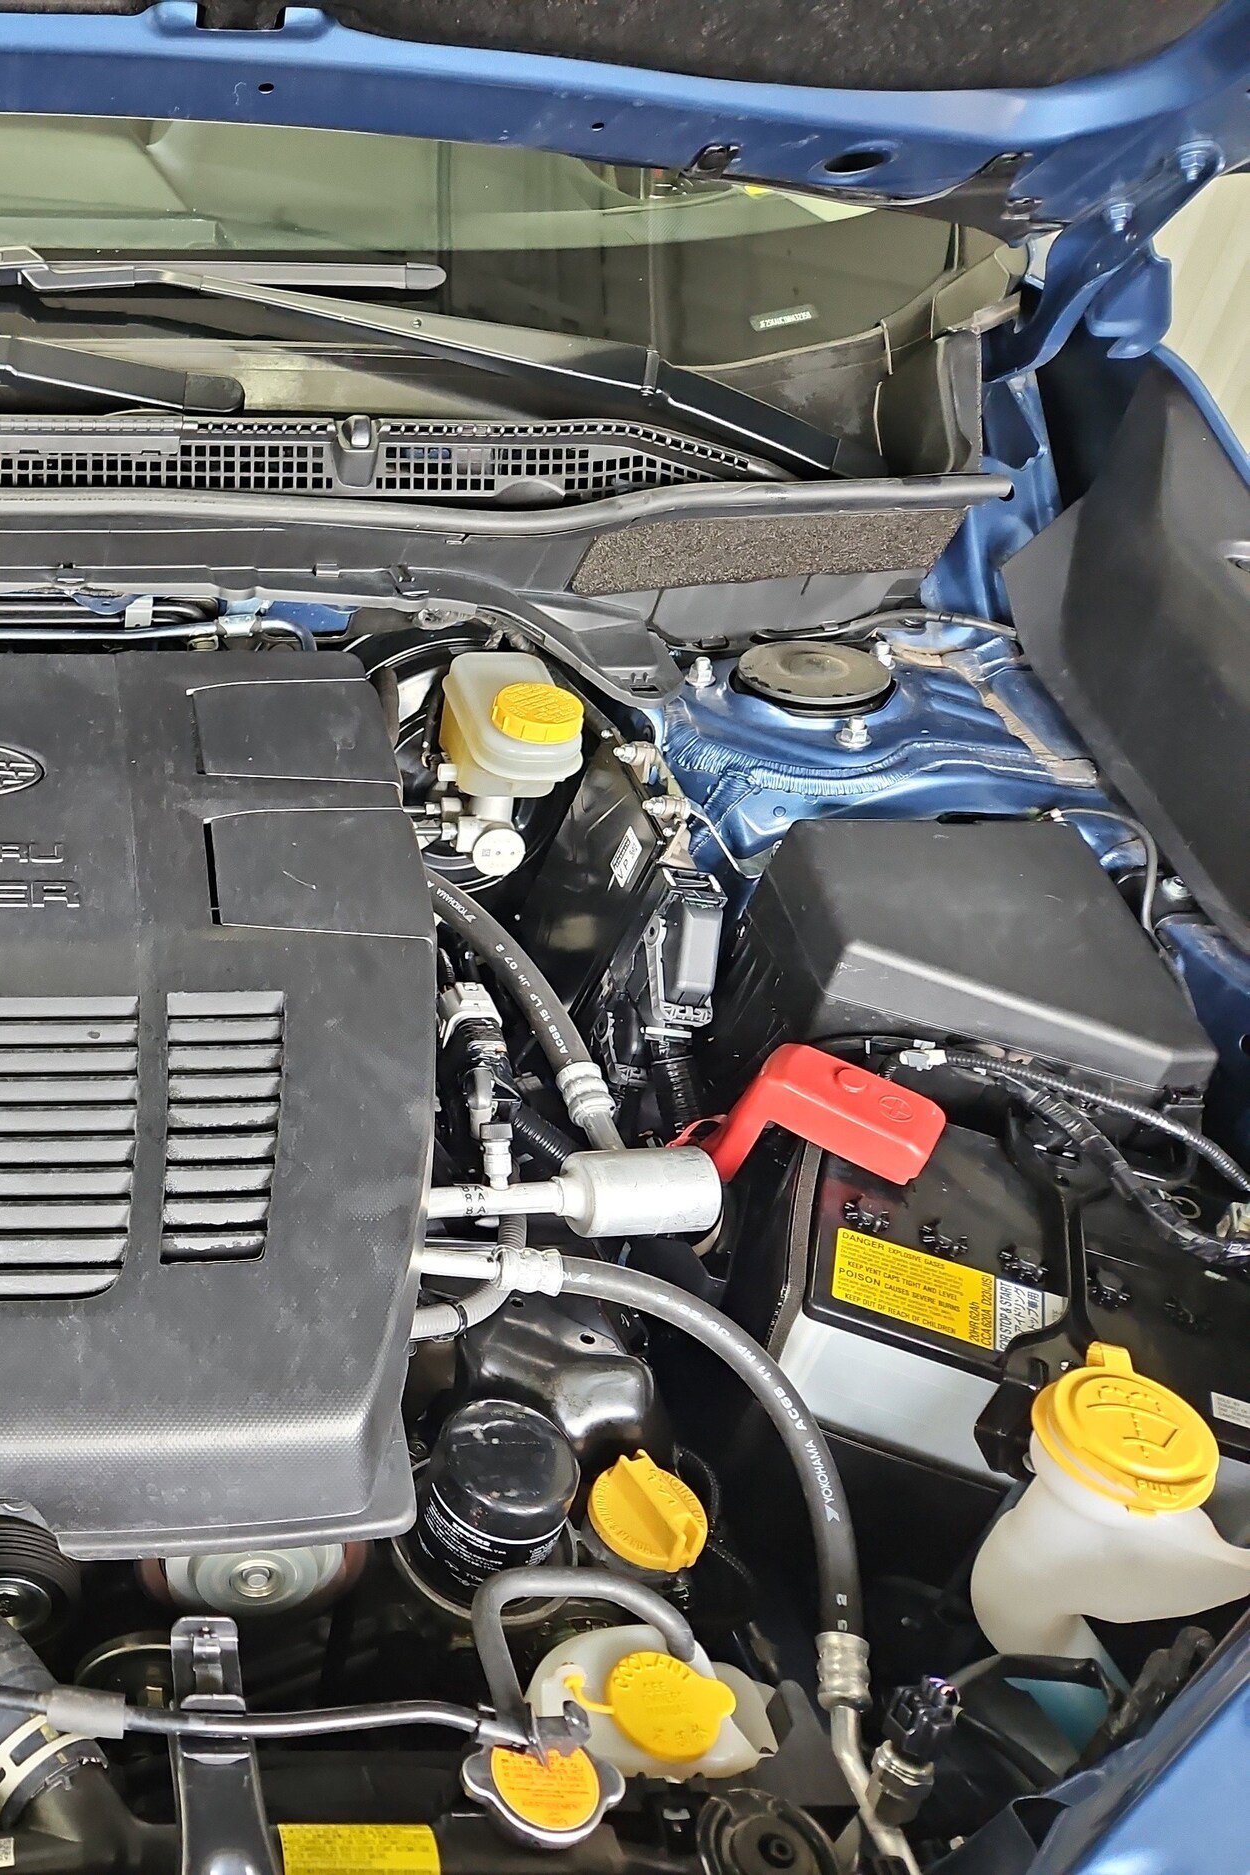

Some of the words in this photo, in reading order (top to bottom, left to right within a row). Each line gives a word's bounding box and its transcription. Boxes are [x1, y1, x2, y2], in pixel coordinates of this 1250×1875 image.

[436, 887, 469, 919] YOKOHAMA
[495, 943, 506, 954] 2
[504, 955, 518, 971] 07
[517, 974, 531, 988] JH
[529, 993, 544, 1008] LP
[539, 1009, 552, 1022] 15
[842, 1231, 884, 1250] DANGER
[888, 1247, 920, 1262] EXPLOSIVE
[924, 1258, 945, 1269] GASES
[838, 1266, 880, 1286] POISON
[884, 1282, 909, 1296] CAUSES
[911, 1291, 934, 1304] SEVERE
[938, 1299, 960, 1312] BURNS
[847, 1260, 863, 1270] KEEP
[865, 1266, 881, 1276] VENT
[883, 1271, 899, 1282] CAPS
[901, 1277, 920, 1289] TIGHT
[923, 1284, 936, 1294] AND
[938, 1289, 958, 1301] LEVEL
[999, 1281, 1012, 1306] START
[844, 1292, 860, 1303] KEEP
[862, 1298, 875, 1308] OUT
[877, 1303, 886, 1311] OF
[888, 1307, 909, 1319] REACH
[922, 1318, 955, 1335] CHILDREN
[969, 1301, 981, 1319] 62Ah
[981, 1308, 993, 1328] 620A
[709, 1320, 731, 1337] JD
[968, 1319, 980, 1342] 20HR
[999, 1313, 1012, 1334] STOP
[981, 1328, 993, 1346] CCA
[734, 1343, 756, 1365] HP
[755, 1365, 773, 1383] 11
[803, 1439, 835, 1505] YOKOHAMA
[612, 1654, 690, 1689] COOLANT
